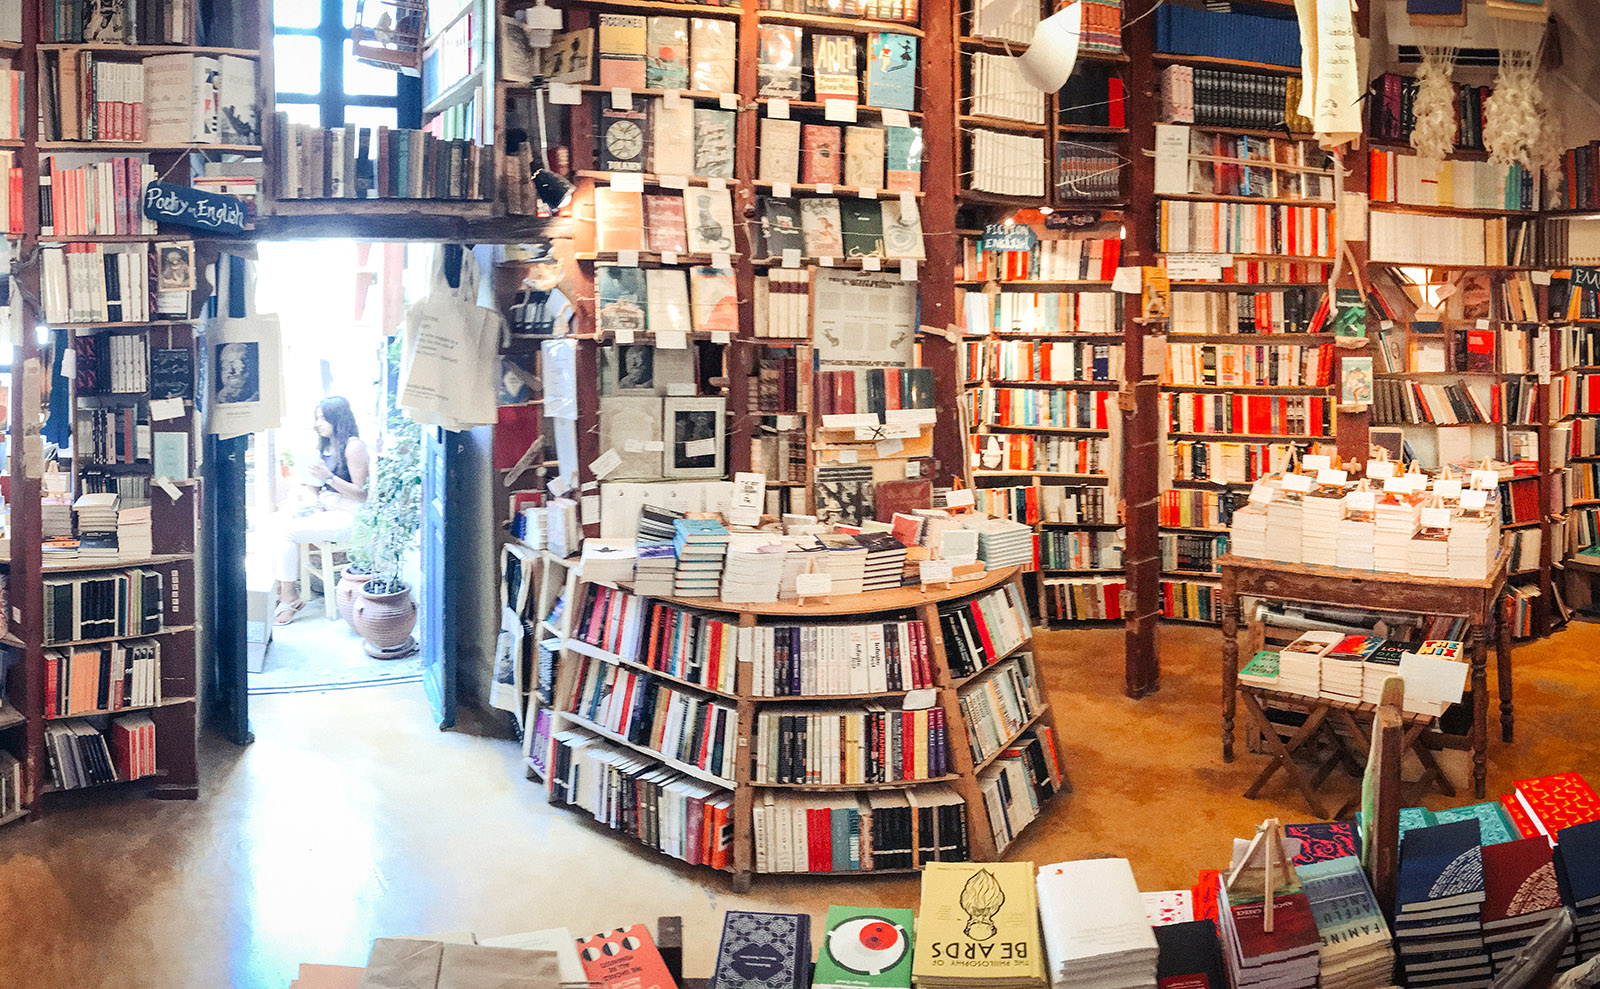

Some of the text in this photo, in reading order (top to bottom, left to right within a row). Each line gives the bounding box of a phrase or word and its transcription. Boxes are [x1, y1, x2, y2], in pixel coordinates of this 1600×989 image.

[817, 36, 858, 73] ARIEL
[197, 199, 247, 229] English
[985, 223, 1030, 236] FICTION
[984, 237, 1031, 249] ENGLISH
[1425, 641, 1459, 649] THE
[1323, 903, 1370, 923] AFFLU
[1320, 923, 1381, 947] FAMINE
[931, 942, 1027, 959] BEARDS
[931, 959, 1030, 968] THE PHILOSOPHY OF
